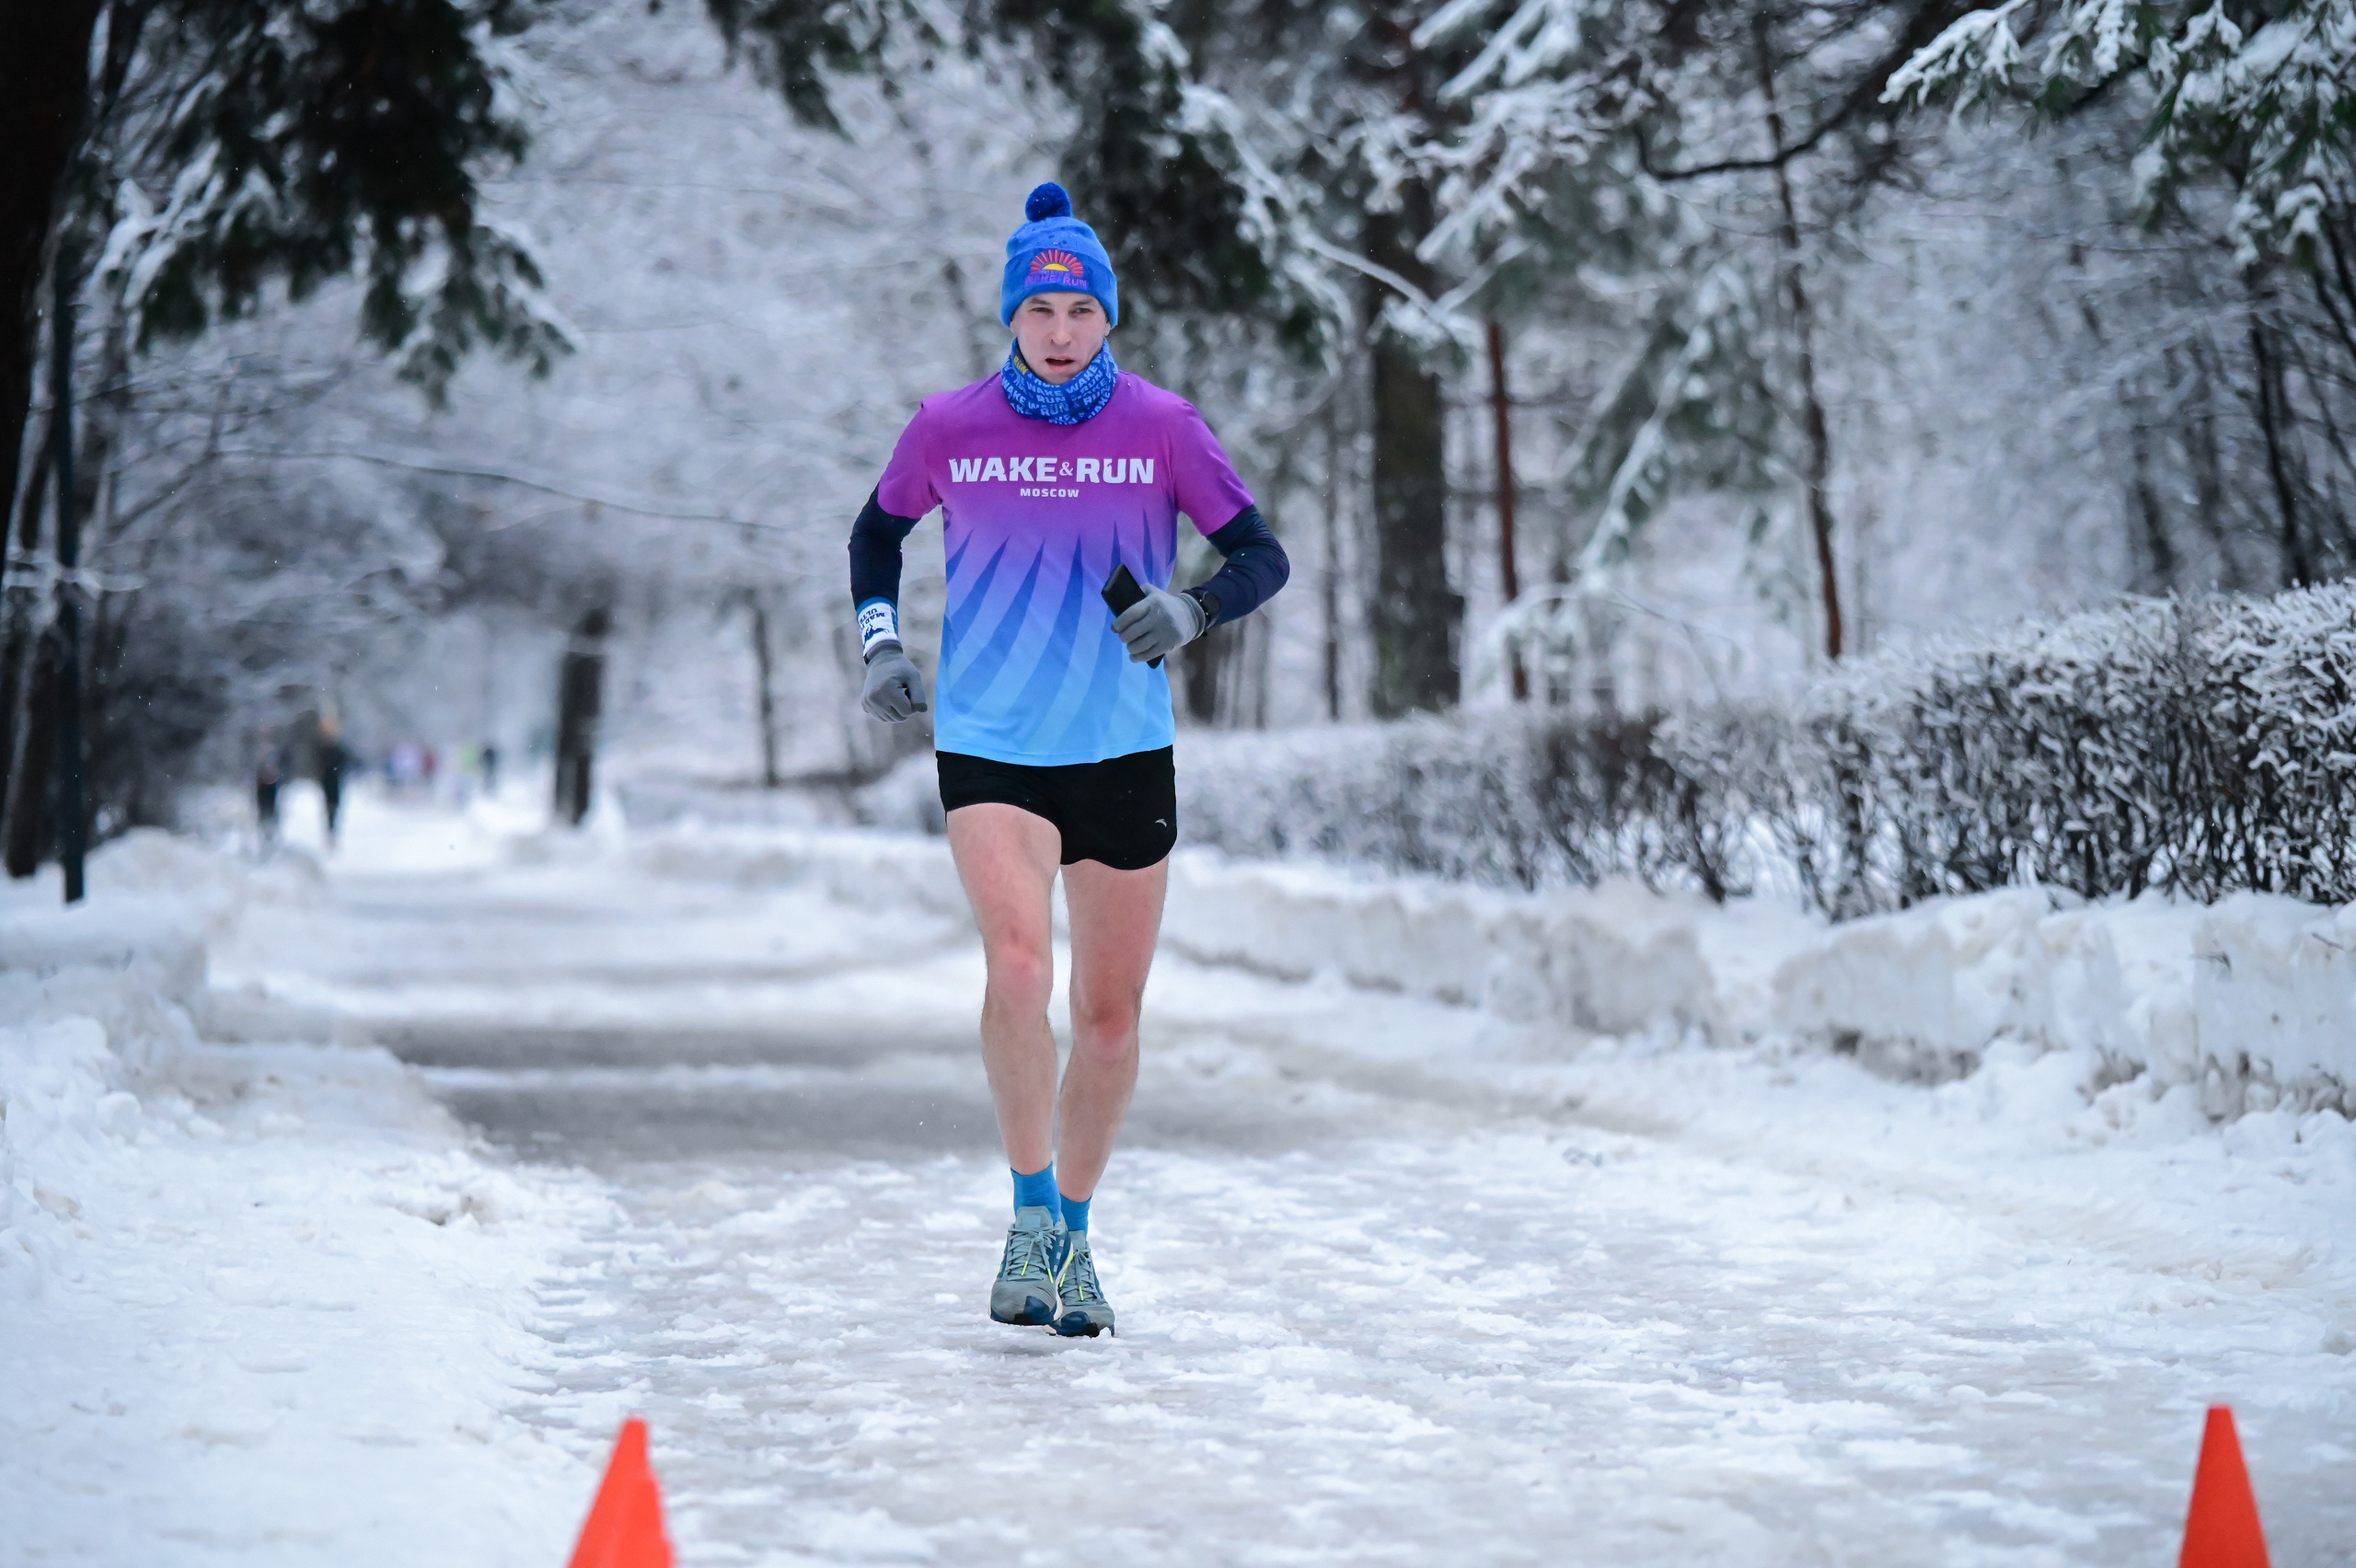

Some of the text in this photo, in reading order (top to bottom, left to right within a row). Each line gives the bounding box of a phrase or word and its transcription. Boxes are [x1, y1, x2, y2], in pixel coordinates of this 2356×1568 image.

[1066, 364, 1098, 394] WAKE
[1001, 377, 1026, 406] WAKE
[1026, 381, 1064, 398] WAKE
[1036, 394, 1066, 404] RUN
[1040, 402, 1069, 416] RUN
[1020, 488, 1079, 498] MOSCOW
[865, 612, 885, 624] MAD
